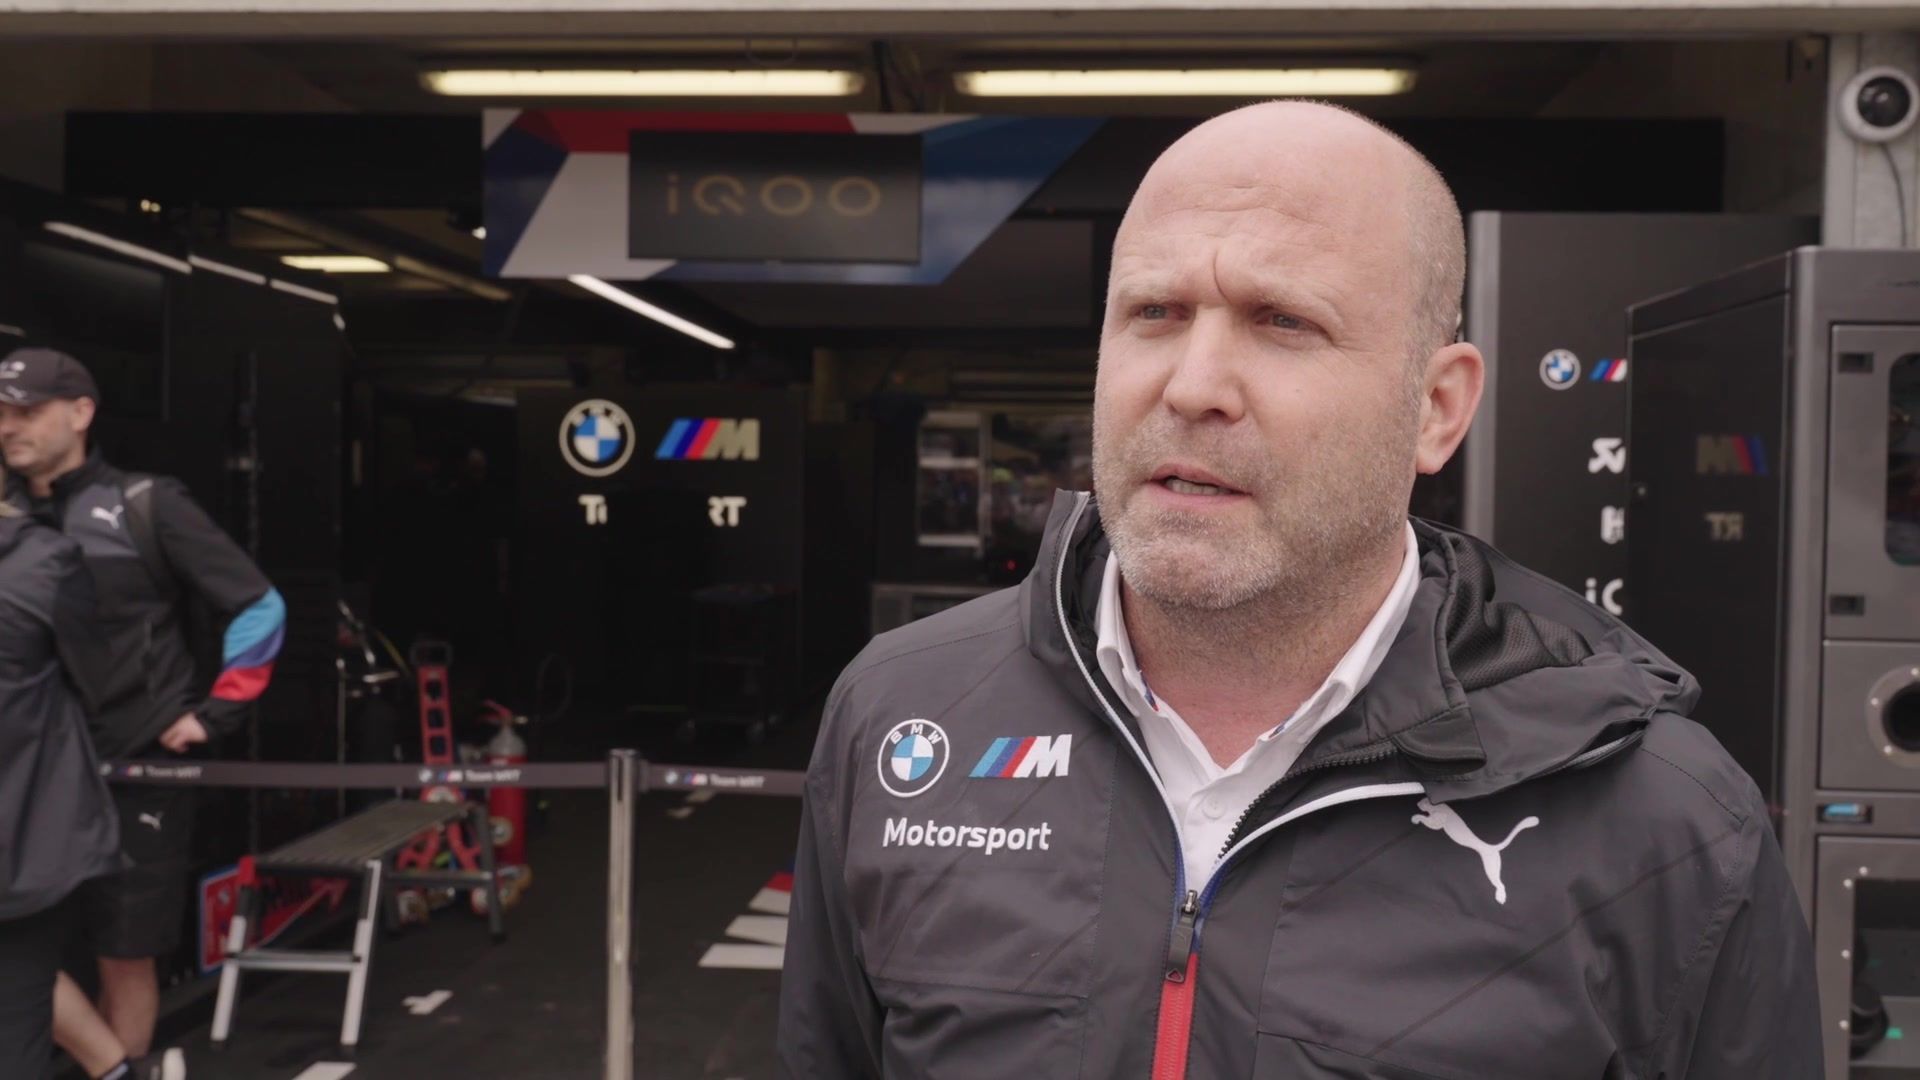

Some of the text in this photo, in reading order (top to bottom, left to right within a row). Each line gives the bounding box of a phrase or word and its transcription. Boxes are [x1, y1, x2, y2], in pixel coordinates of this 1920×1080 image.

[667, 174, 881, 217] iQOO
[890, 723, 942, 746] BMW
[883, 817, 1052, 856] Motorsport
